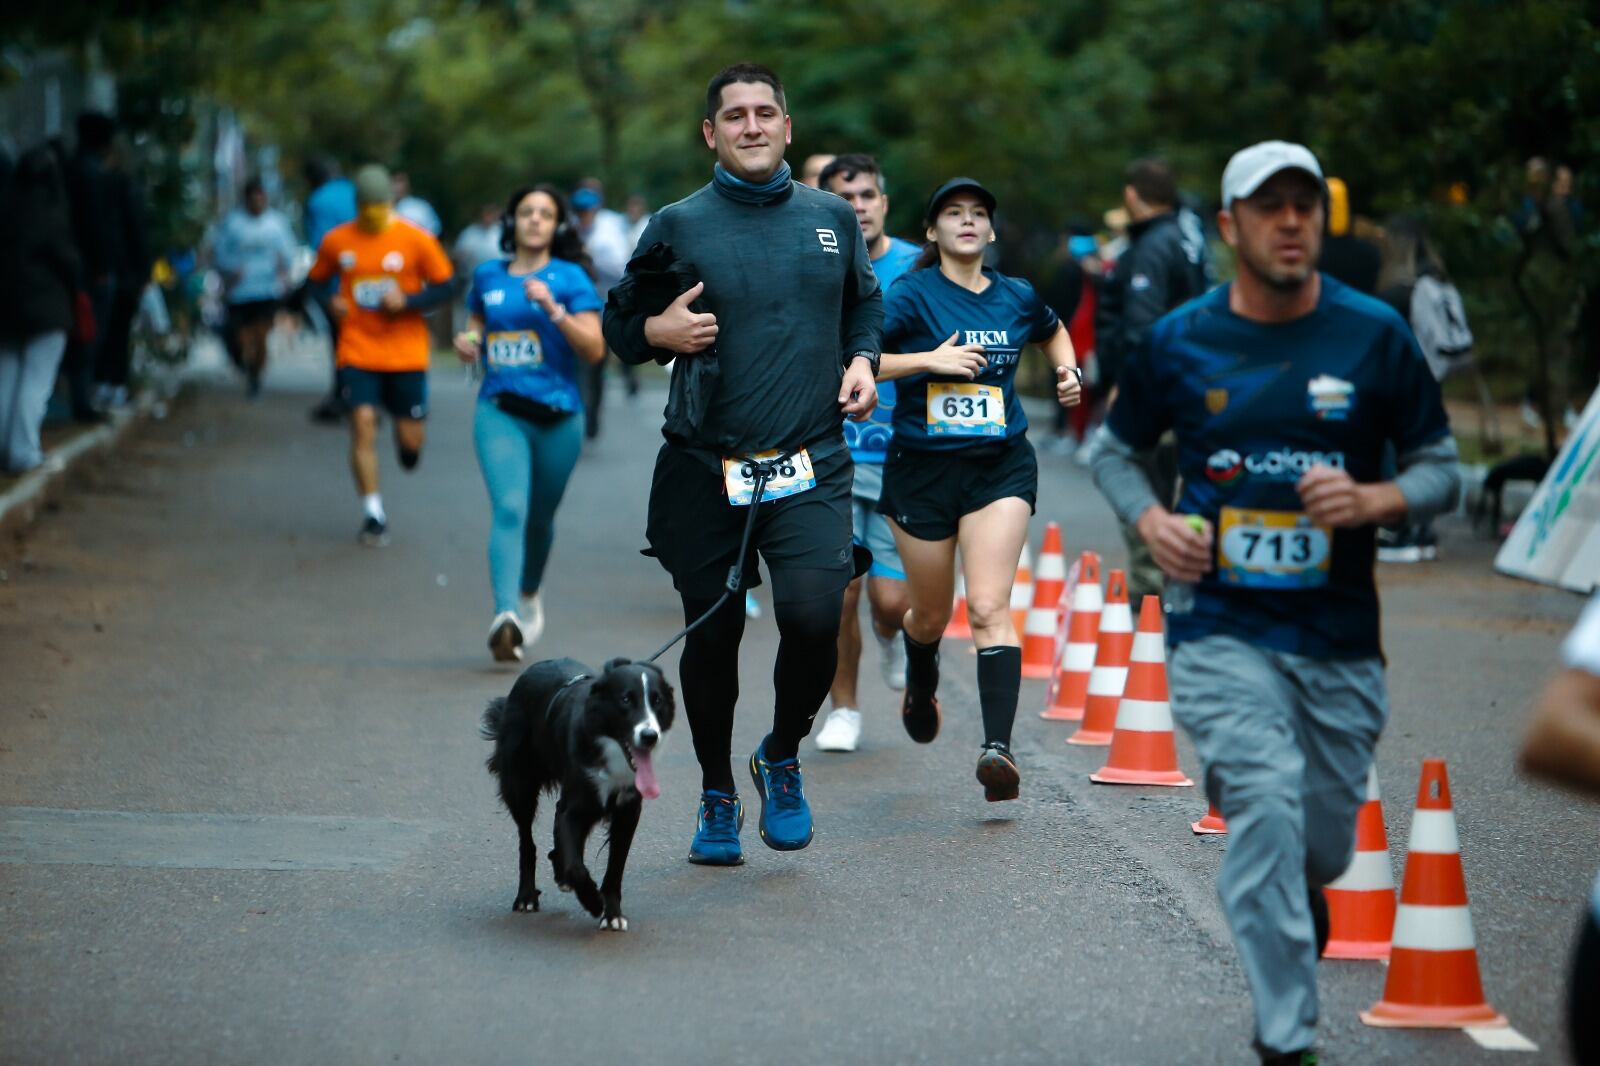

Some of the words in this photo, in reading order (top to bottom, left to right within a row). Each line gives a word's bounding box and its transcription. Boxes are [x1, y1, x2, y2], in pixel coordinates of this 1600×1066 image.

[964, 330, 1010, 346] BKM
[942, 397, 988, 418] 631
[1240, 531, 1312, 564] 713
